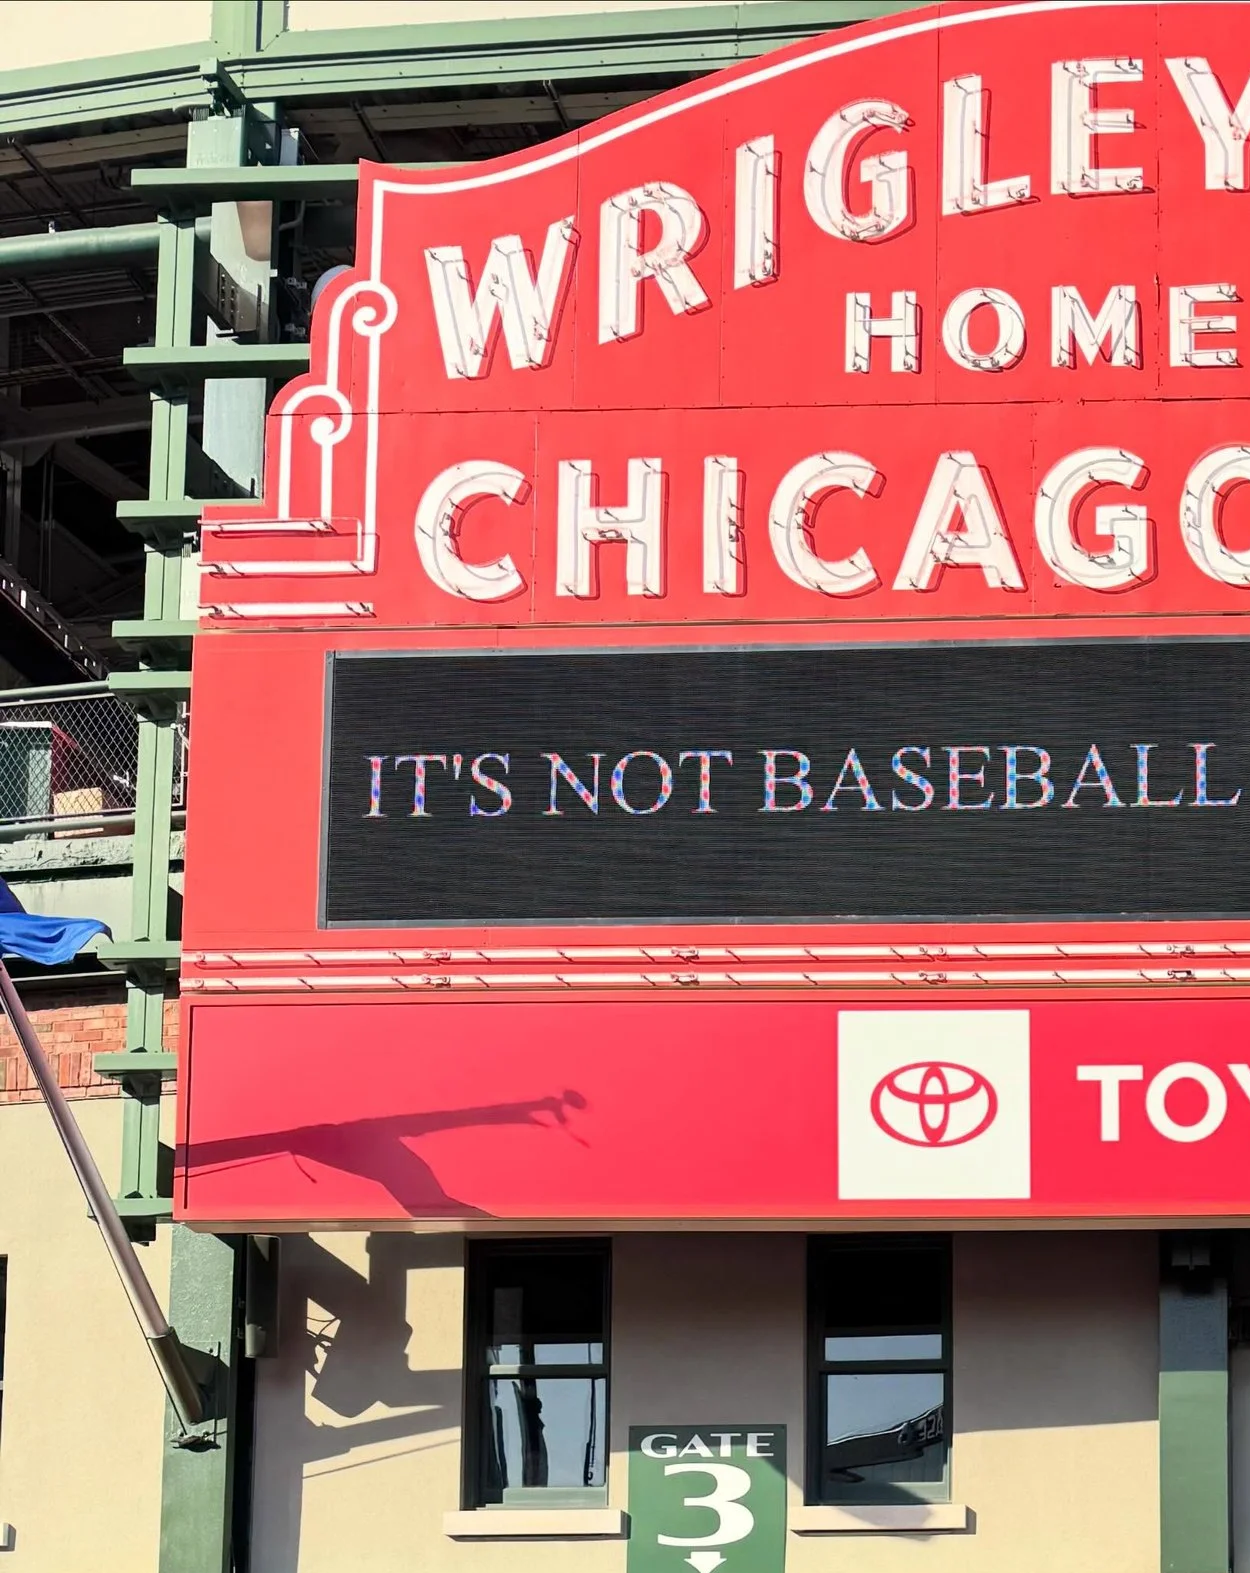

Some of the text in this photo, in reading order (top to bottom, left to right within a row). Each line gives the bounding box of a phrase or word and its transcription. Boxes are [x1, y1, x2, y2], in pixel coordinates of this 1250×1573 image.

[845, 283, 1239, 374] HOME
[362, 751, 512, 818] IT'S
[543, 749, 733, 817] NOT
[758, 742, 1241, 813] BASEBALL
[640, 1432, 774, 1458] GATE
[658, 1463, 753, 1546] 3
